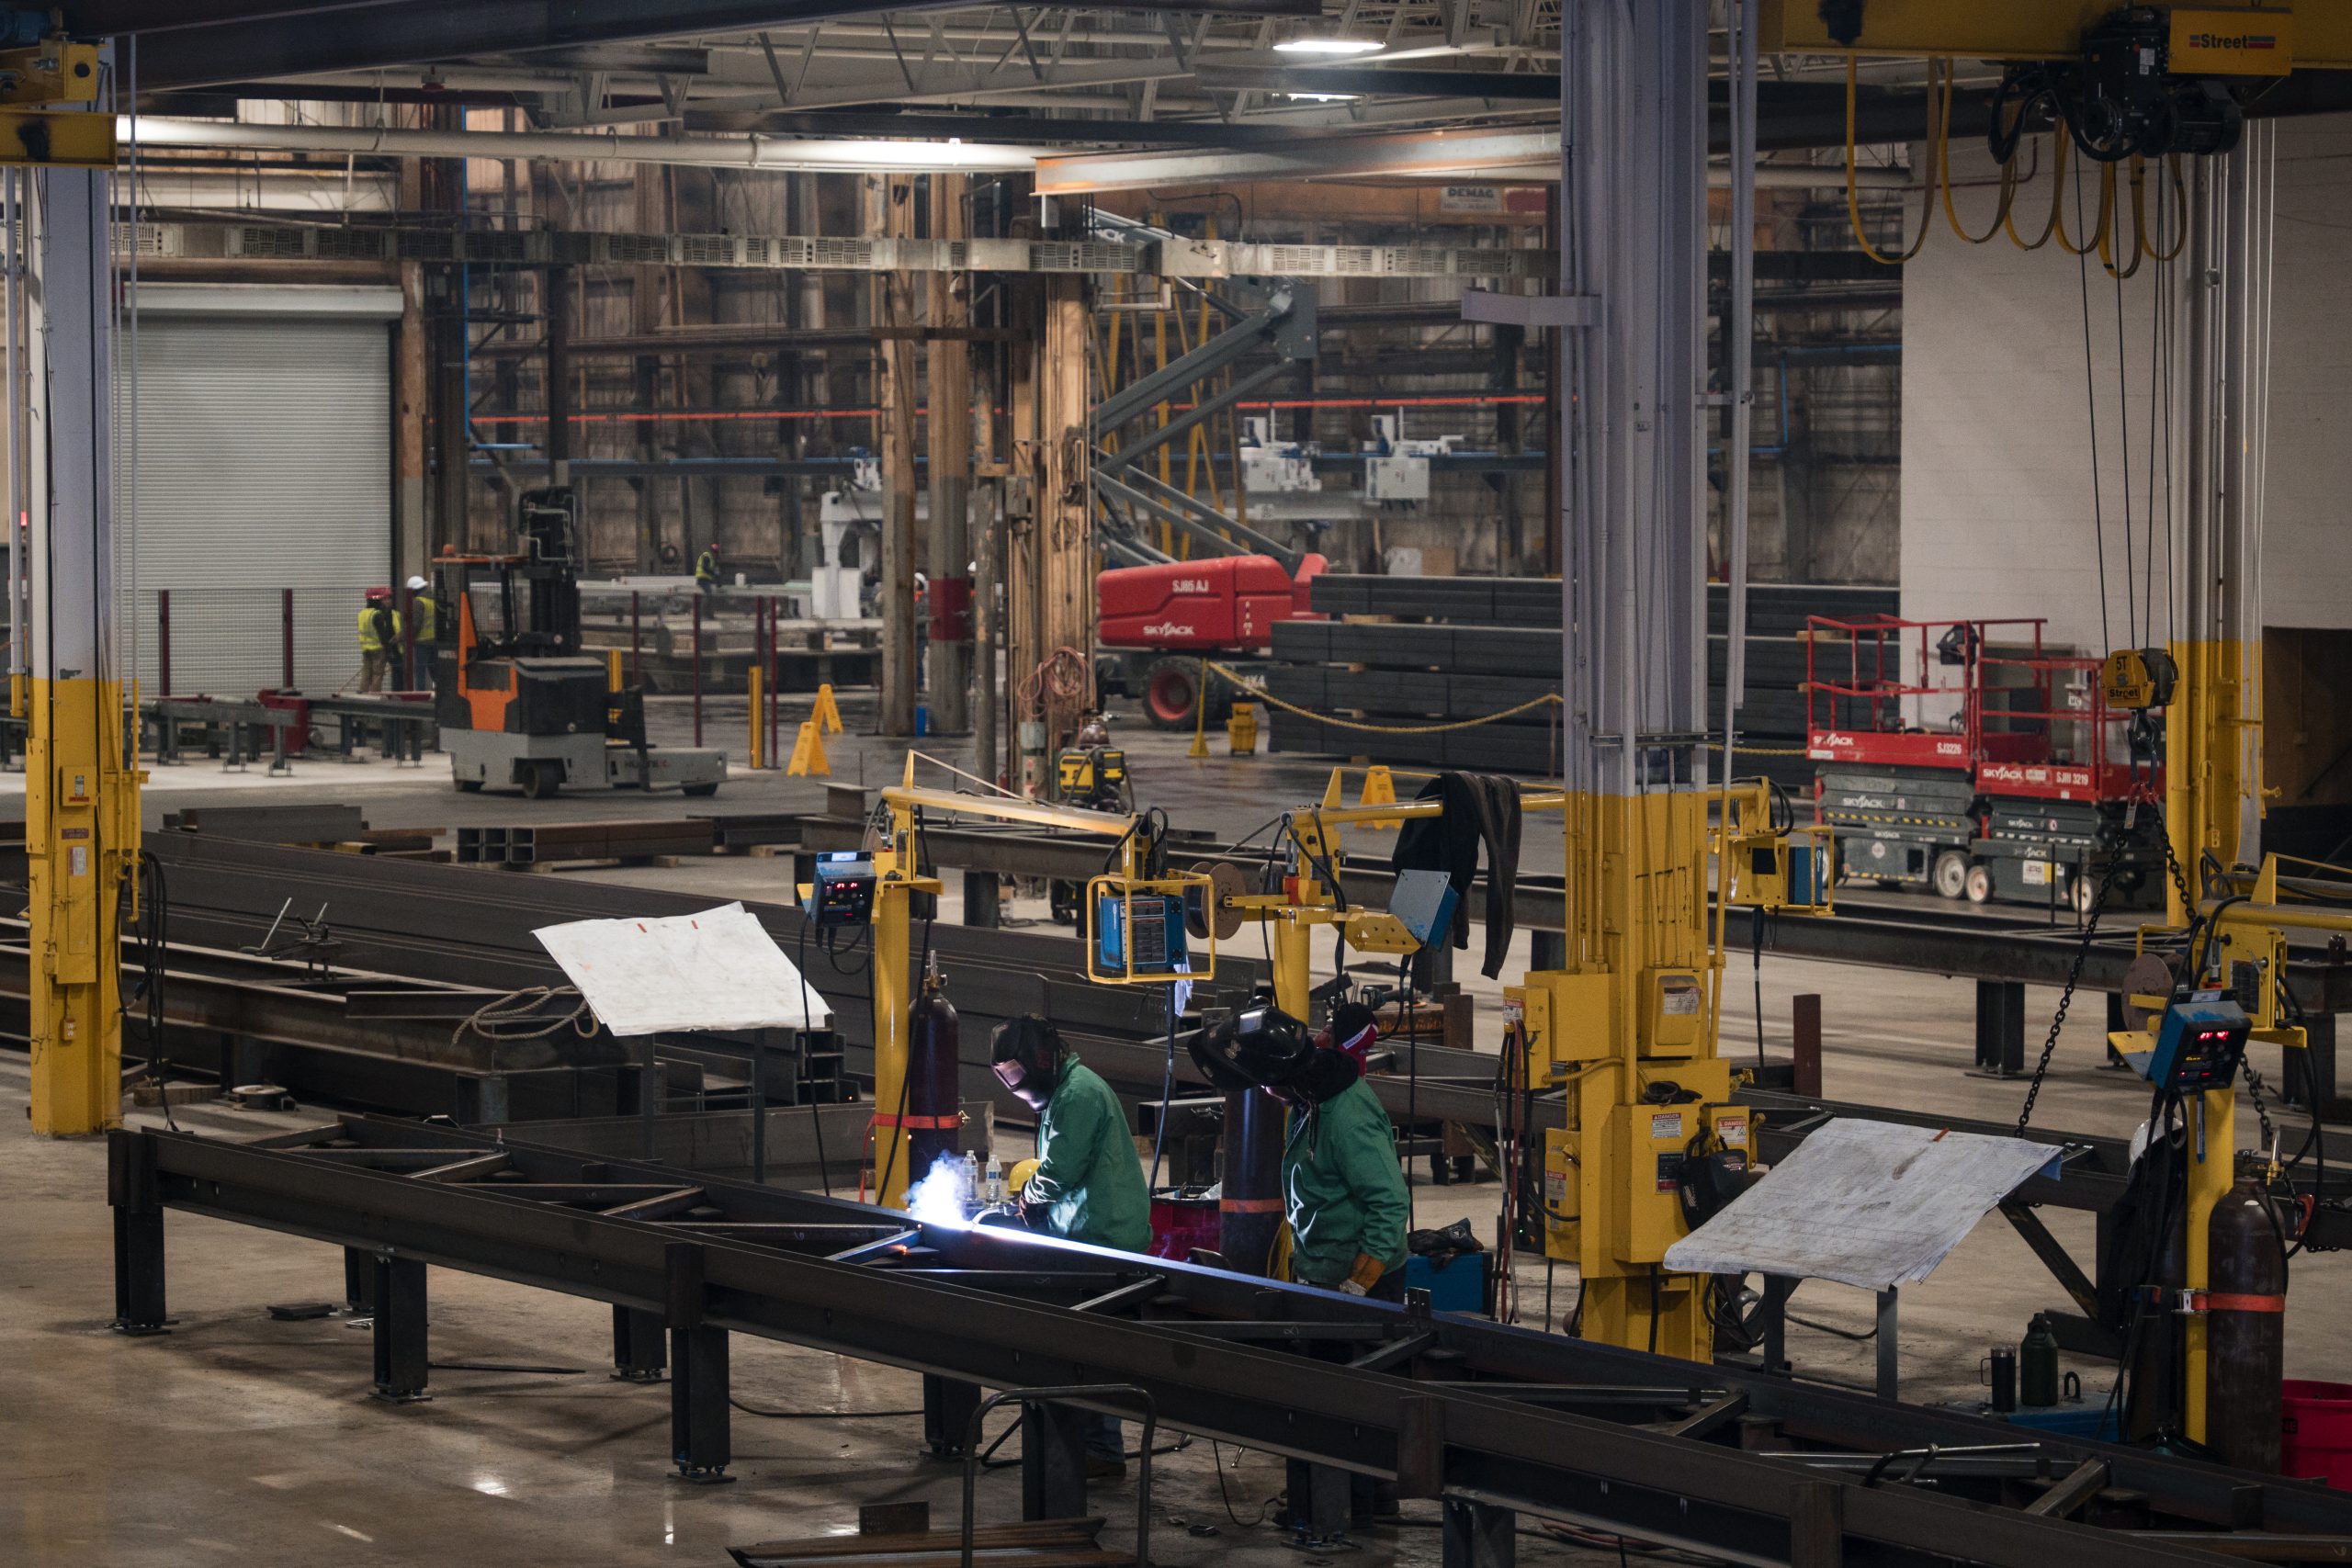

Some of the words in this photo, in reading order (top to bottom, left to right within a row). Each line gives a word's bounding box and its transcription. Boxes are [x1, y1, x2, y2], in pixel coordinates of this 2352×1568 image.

[2200, 34, 2248, 50] Street
[1448, 187, 1494, 197] DEMAG
[1143, 621, 1194, 637] SKYJACK
[2116, 656, 2127, 671] 5T
[1813, 733, 1854, 747] SJACK
[1937, 742, 1962, 755] SJ3226
[1983, 766, 2023, 780] SKYJACK
[2073, 773, 2089, 786] 3219
[1843, 795, 1884, 808] SKYJACK
